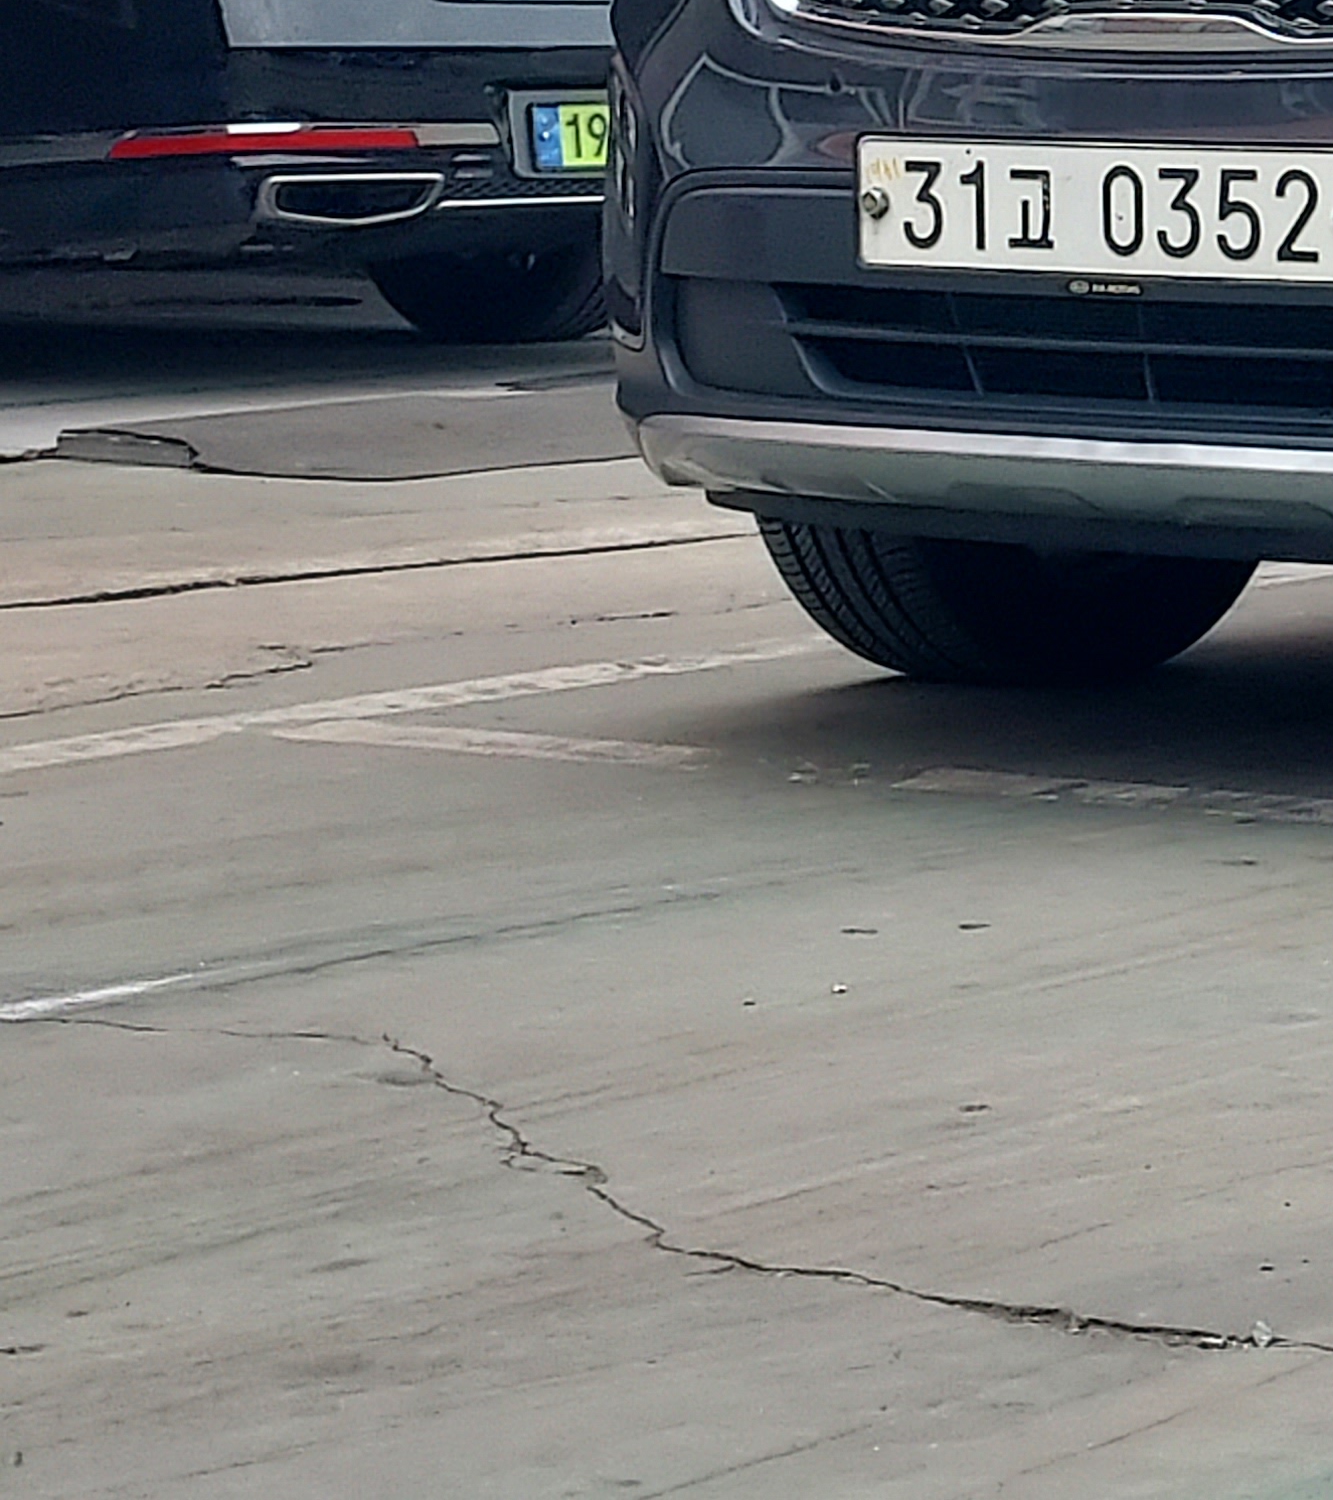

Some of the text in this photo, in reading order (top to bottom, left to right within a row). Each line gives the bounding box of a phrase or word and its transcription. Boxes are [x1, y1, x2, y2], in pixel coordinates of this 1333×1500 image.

[564, 113, 607, 159] 19
[903, 159, 1321, 264] 31고 0352
